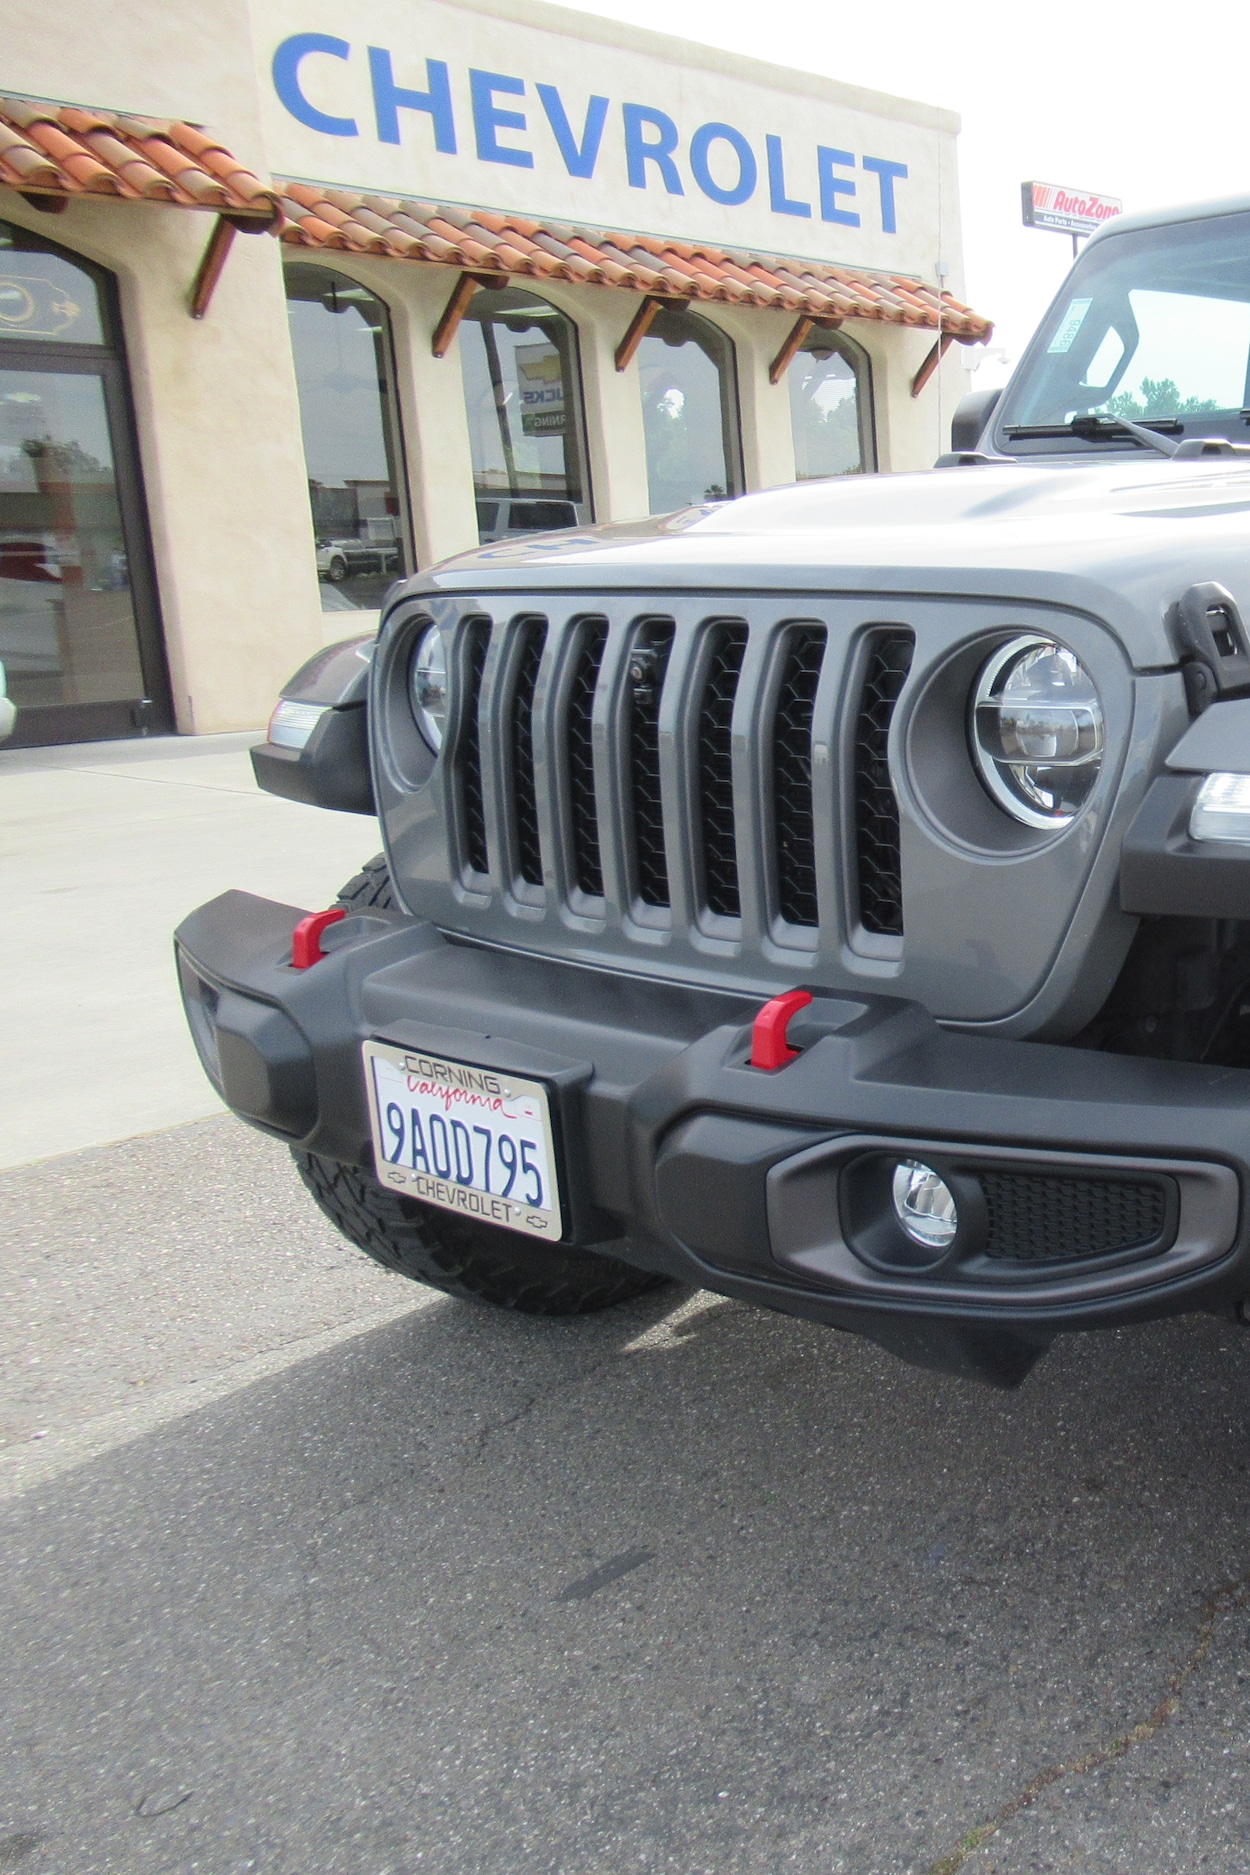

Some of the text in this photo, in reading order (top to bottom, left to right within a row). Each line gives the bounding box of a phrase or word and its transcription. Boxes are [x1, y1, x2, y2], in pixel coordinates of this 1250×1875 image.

[272, 32, 908, 234] CHEVROLET
[405, 1055, 501, 1095] CORNING
[415, 1176, 512, 1222] CHEVROLET
